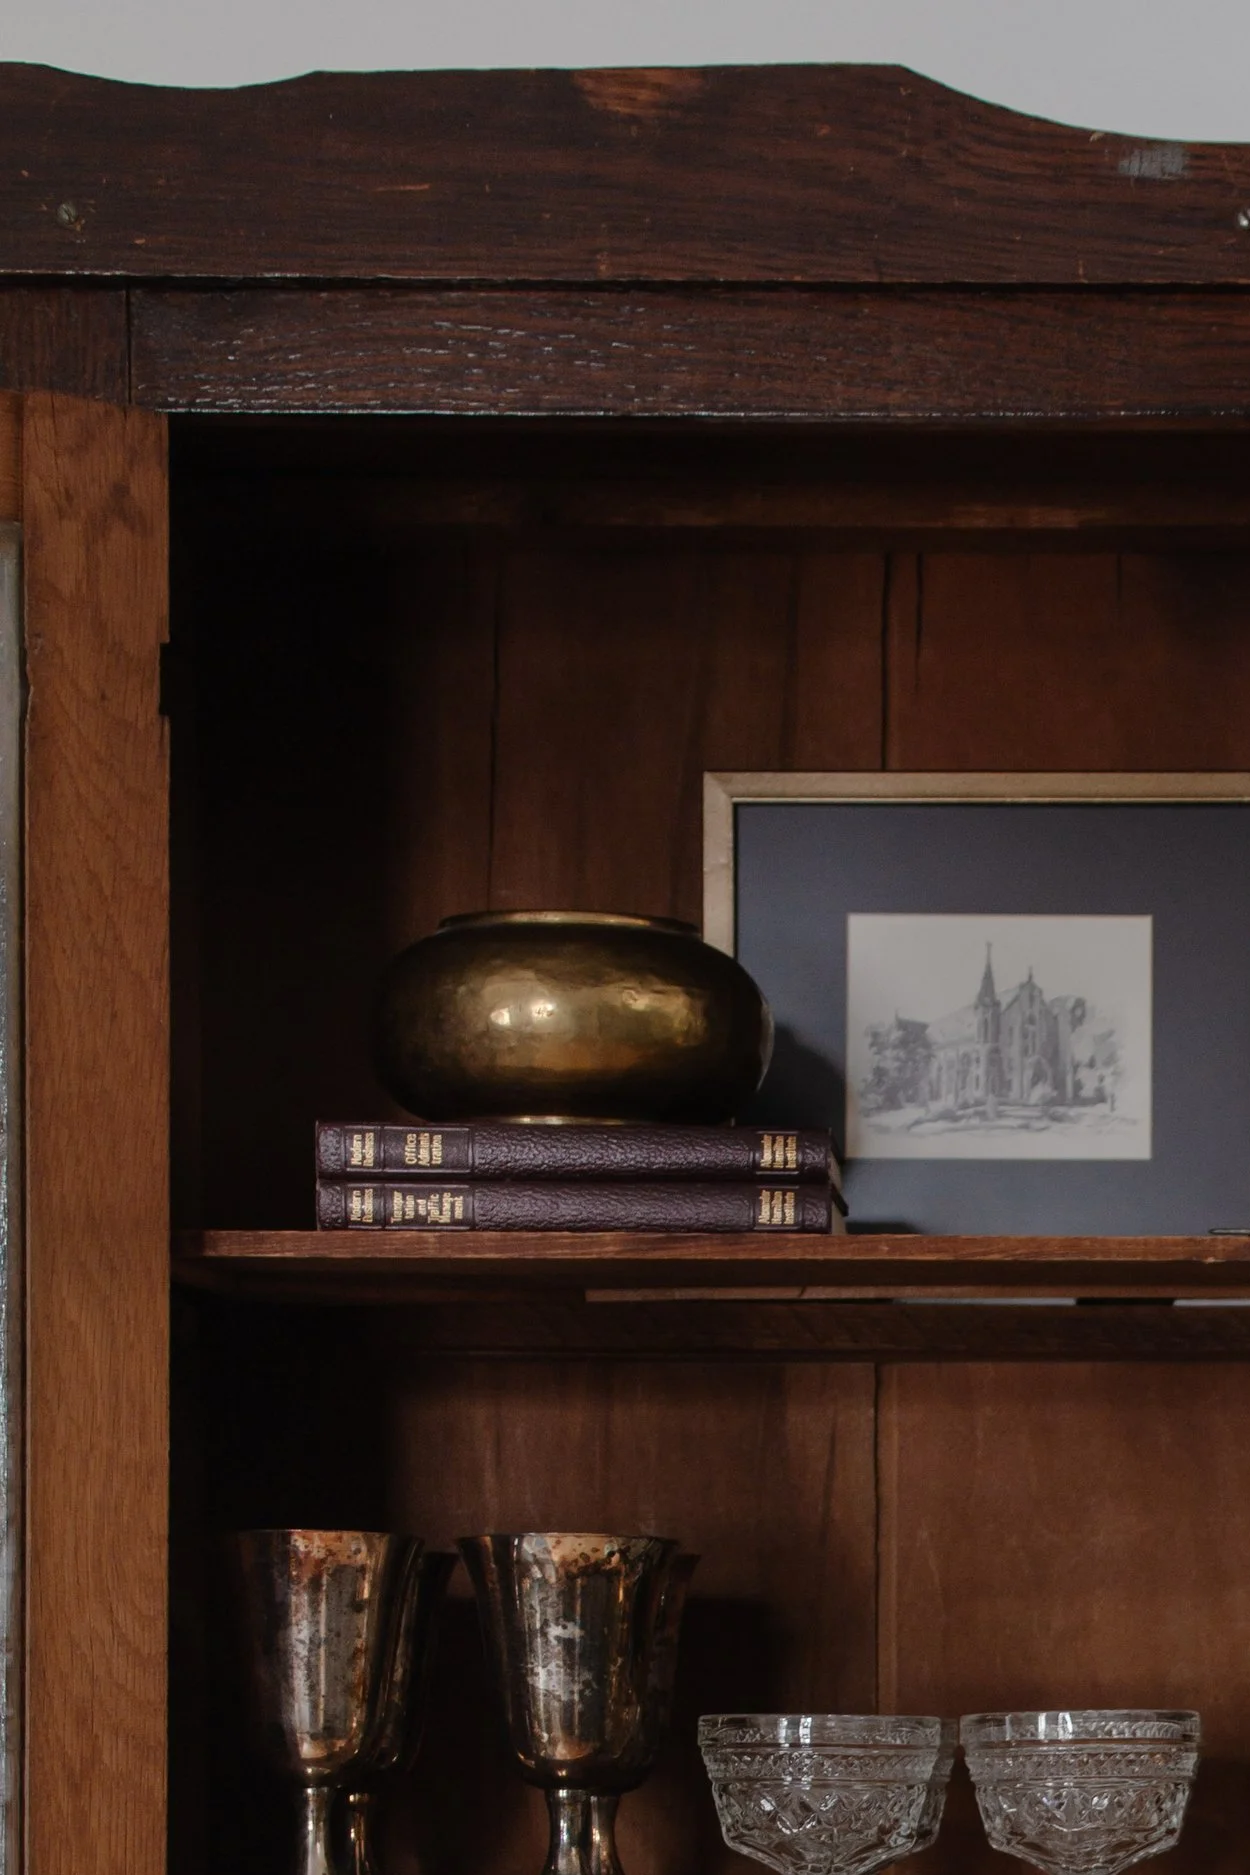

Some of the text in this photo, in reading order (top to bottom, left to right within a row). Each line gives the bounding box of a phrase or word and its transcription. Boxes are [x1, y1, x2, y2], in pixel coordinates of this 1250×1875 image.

[405, 1133, 417, 1164] Office
[416, 1199, 427, 1216] and
[428, 1193, 440, 1223] Traffic
